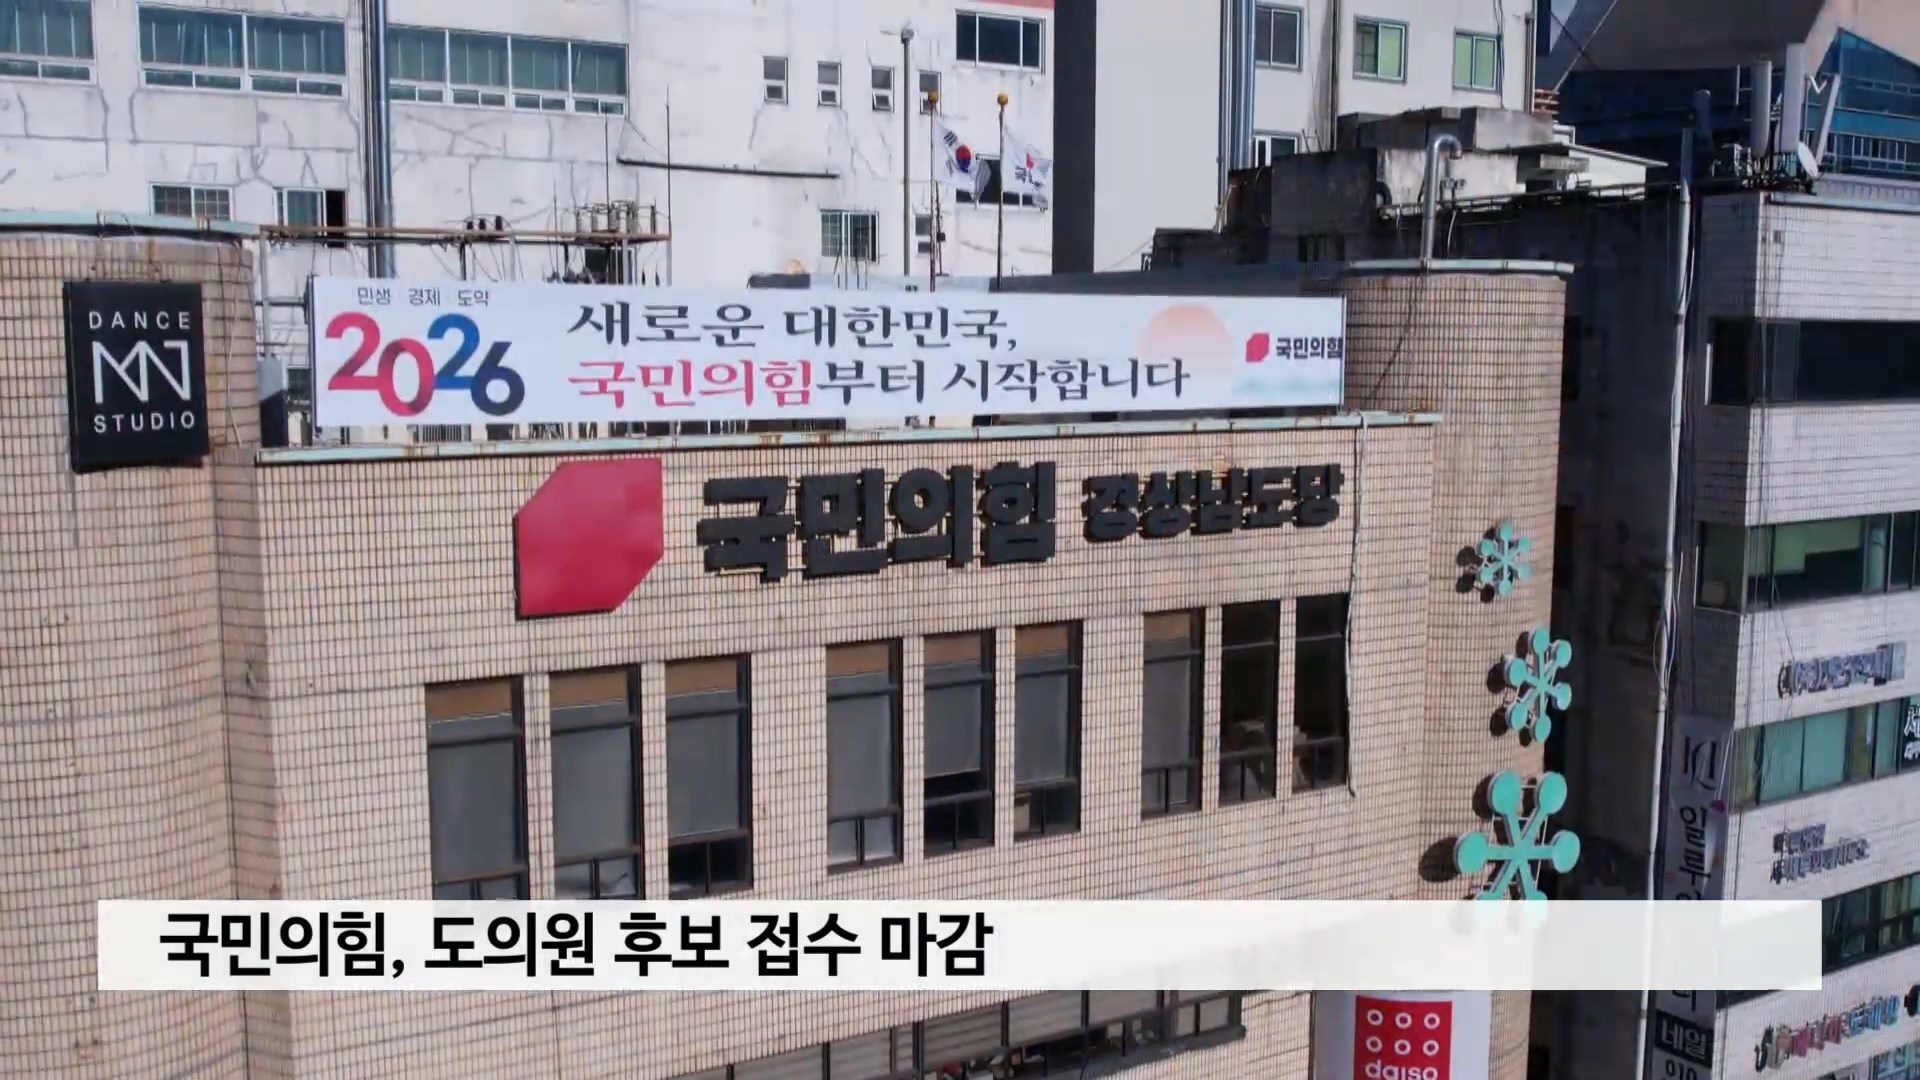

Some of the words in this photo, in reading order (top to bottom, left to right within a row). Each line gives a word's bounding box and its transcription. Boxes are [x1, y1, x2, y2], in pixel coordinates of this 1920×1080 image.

[357, 286, 391, 306] 민생
[408, 287, 441, 307] 경제
[457, 289, 490, 308] 도약
[89, 311, 191, 330] DANCE
[567, 301, 765, 348] 새로운
[783, 304, 1017, 352] 대한민국,
[1276, 336, 1343, 360] 국민의힘
[325, 311, 526, 417] 2026
[568, 358, 925, 409] 국민의힘부터
[943, 357, 1191, 403] 시작합니다
[94, 410, 195, 434] STUDIO
[697, 461, 1056, 584] 국민의힘
[1365, 1059, 1439, 1080] daiso
